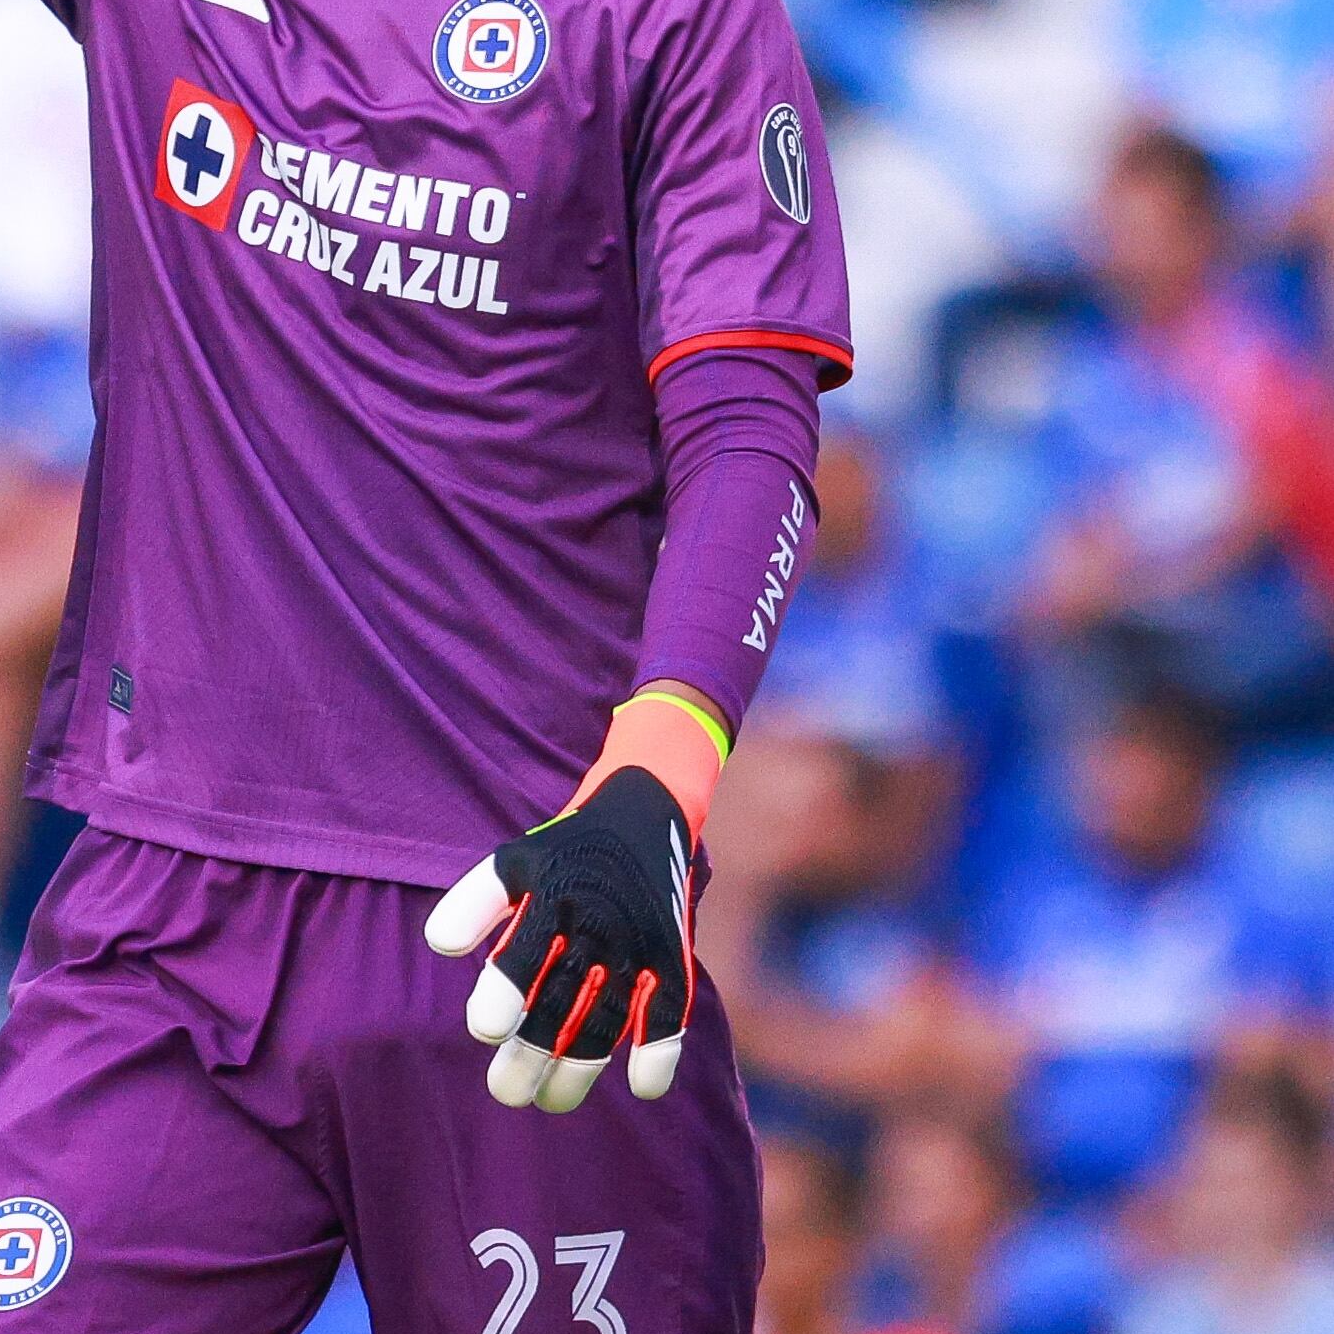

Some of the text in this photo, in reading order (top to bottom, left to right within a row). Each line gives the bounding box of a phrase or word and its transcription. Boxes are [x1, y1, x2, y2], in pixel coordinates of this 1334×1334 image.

[447, 77, 525, 99] CRUZ AZUL
[787, 134, 797, 157] 9
[236, 188, 509, 316] CRUZ AZUL
[742, 479, 806, 652] PIRMA
[3, 1202, 21, 1214] DE
[9, 1285, 44, 1305] AZUL
